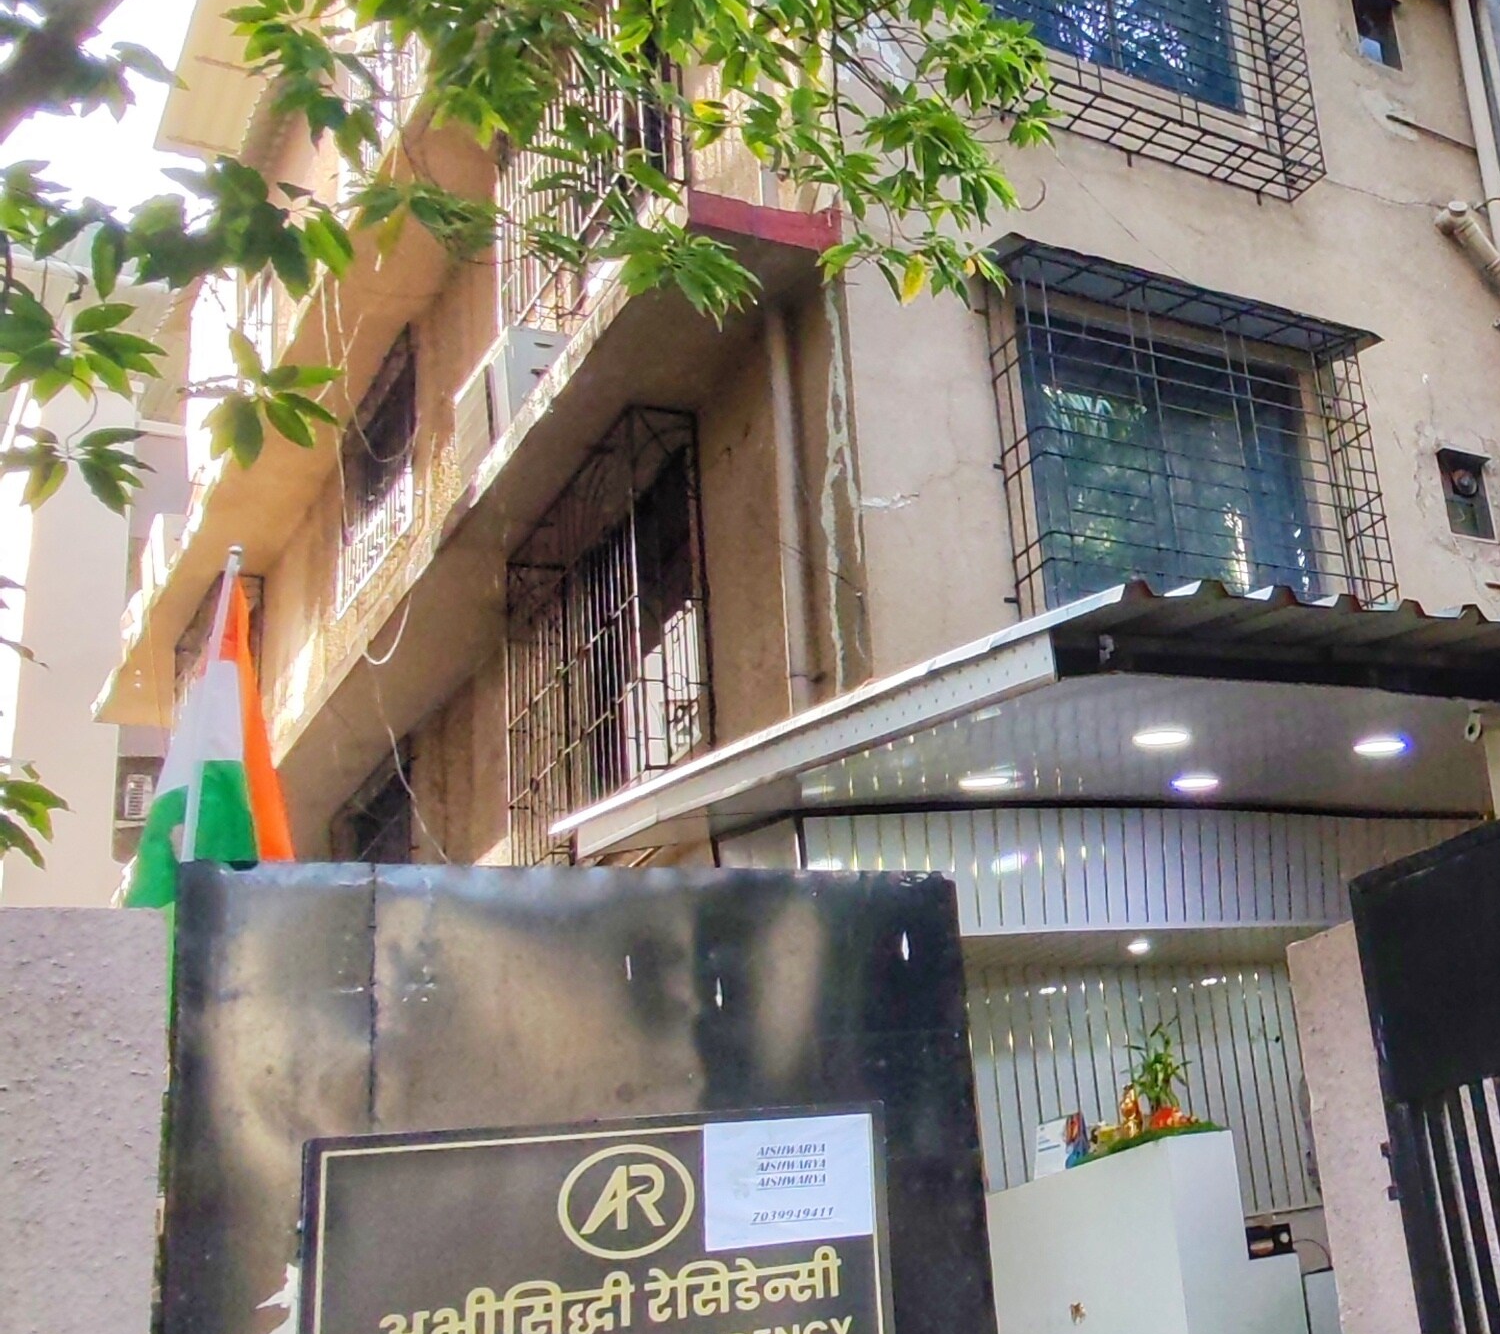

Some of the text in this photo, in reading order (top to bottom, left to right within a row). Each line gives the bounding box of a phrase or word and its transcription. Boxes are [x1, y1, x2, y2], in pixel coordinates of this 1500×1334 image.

[756, 1143, 826, 1157] AISHWARYA
[756, 1158, 826, 1172] AISHWARYA
[757, 1173, 826, 1188] AISHWARYA
[643, 1245, 843, 1323] रेसिडेन्सी
